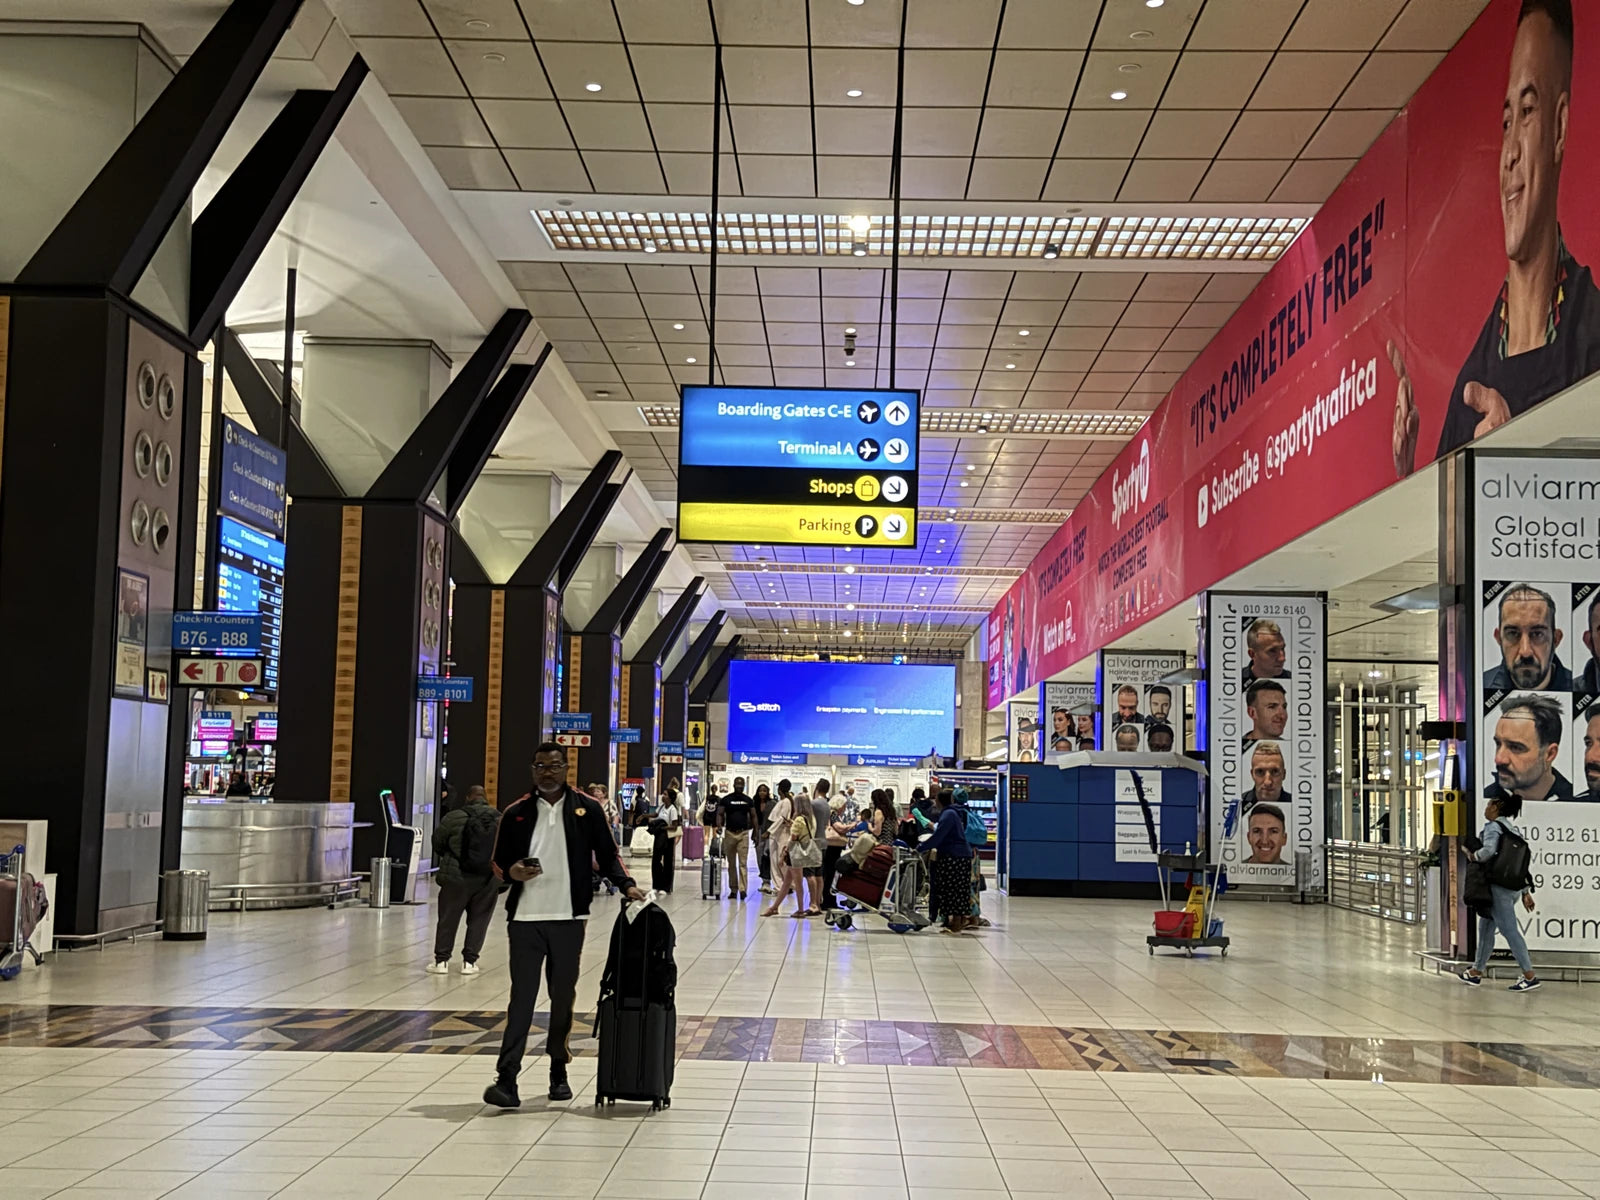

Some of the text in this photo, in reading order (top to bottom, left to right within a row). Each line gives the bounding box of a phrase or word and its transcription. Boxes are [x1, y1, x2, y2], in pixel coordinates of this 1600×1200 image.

[1220, 272, 1317, 424] COMPLETELY
[717, 402, 852, 420] Boarding Gates C-E
[1211, 356, 1377, 515] Subscribe @sportytvafrica
[778, 440, 855, 456] Terminal A
[809, 478, 854, 498] Shops
[799, 517, 852, 535] Parking
[1494, 515, 1584, 537] Global
[1484, 581, 1503, 600] BEFORE
[1575, 585, 1591, 601] AFTER
[1243, 605, 1306, 615] 010 312 6140
[173, 615, 255, 625] Check-In Counters
[180, 631, 207, 645] B76
[221, 632, 248, 646] B88
[1107, 656, 1184, 669] alviarmani
[418, 688, 437, 698] B89
[444, 689, 467, 699] B101
[1484, 689, 1505, 708] BEFORE
[756, 703, 781, 712] stitch
[1576, 694, 1593, 710] AFTER
[1546, 827, 1576, 842] 312
[1581, 828, 1600, 843] 61
[1530, 848, 1600, 867] viarma
[1552, 874, 1584, 890] 329
